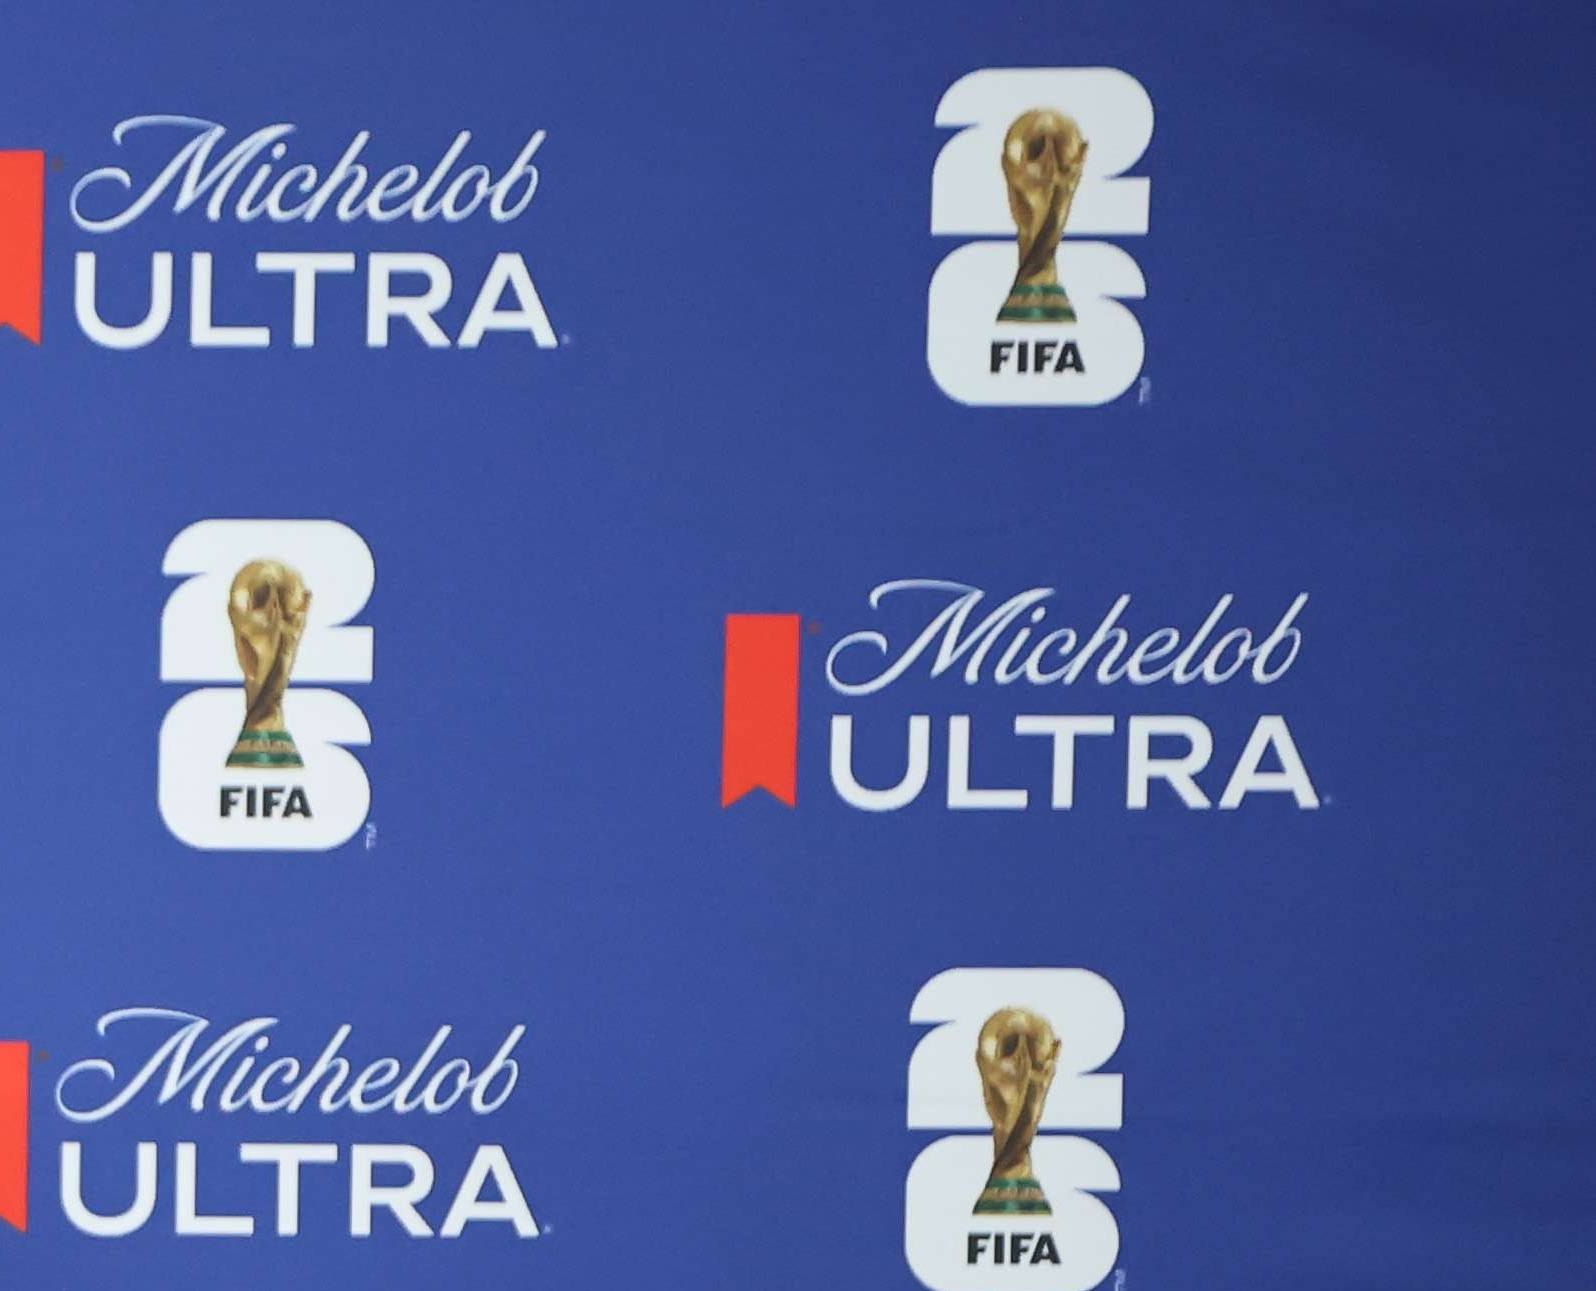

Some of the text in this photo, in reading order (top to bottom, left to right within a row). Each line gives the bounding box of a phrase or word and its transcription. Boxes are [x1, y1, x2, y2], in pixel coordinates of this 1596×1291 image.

[69, 115, 546, 233] Michelob
[74, 251, 558, 350] ULTRA
[990, 341, 1085, 374] FIFA
[825, 579, 1309, 696] Michelob
[219, 786, 313, 818] FIFA
[829, 714, 1320, 813] ULTRA
[55, 1007, 526, 1123] Michelob
[60, 1141, 540, 1238] ULTRA
[967, 1233, 1061, 1265] FIFA
